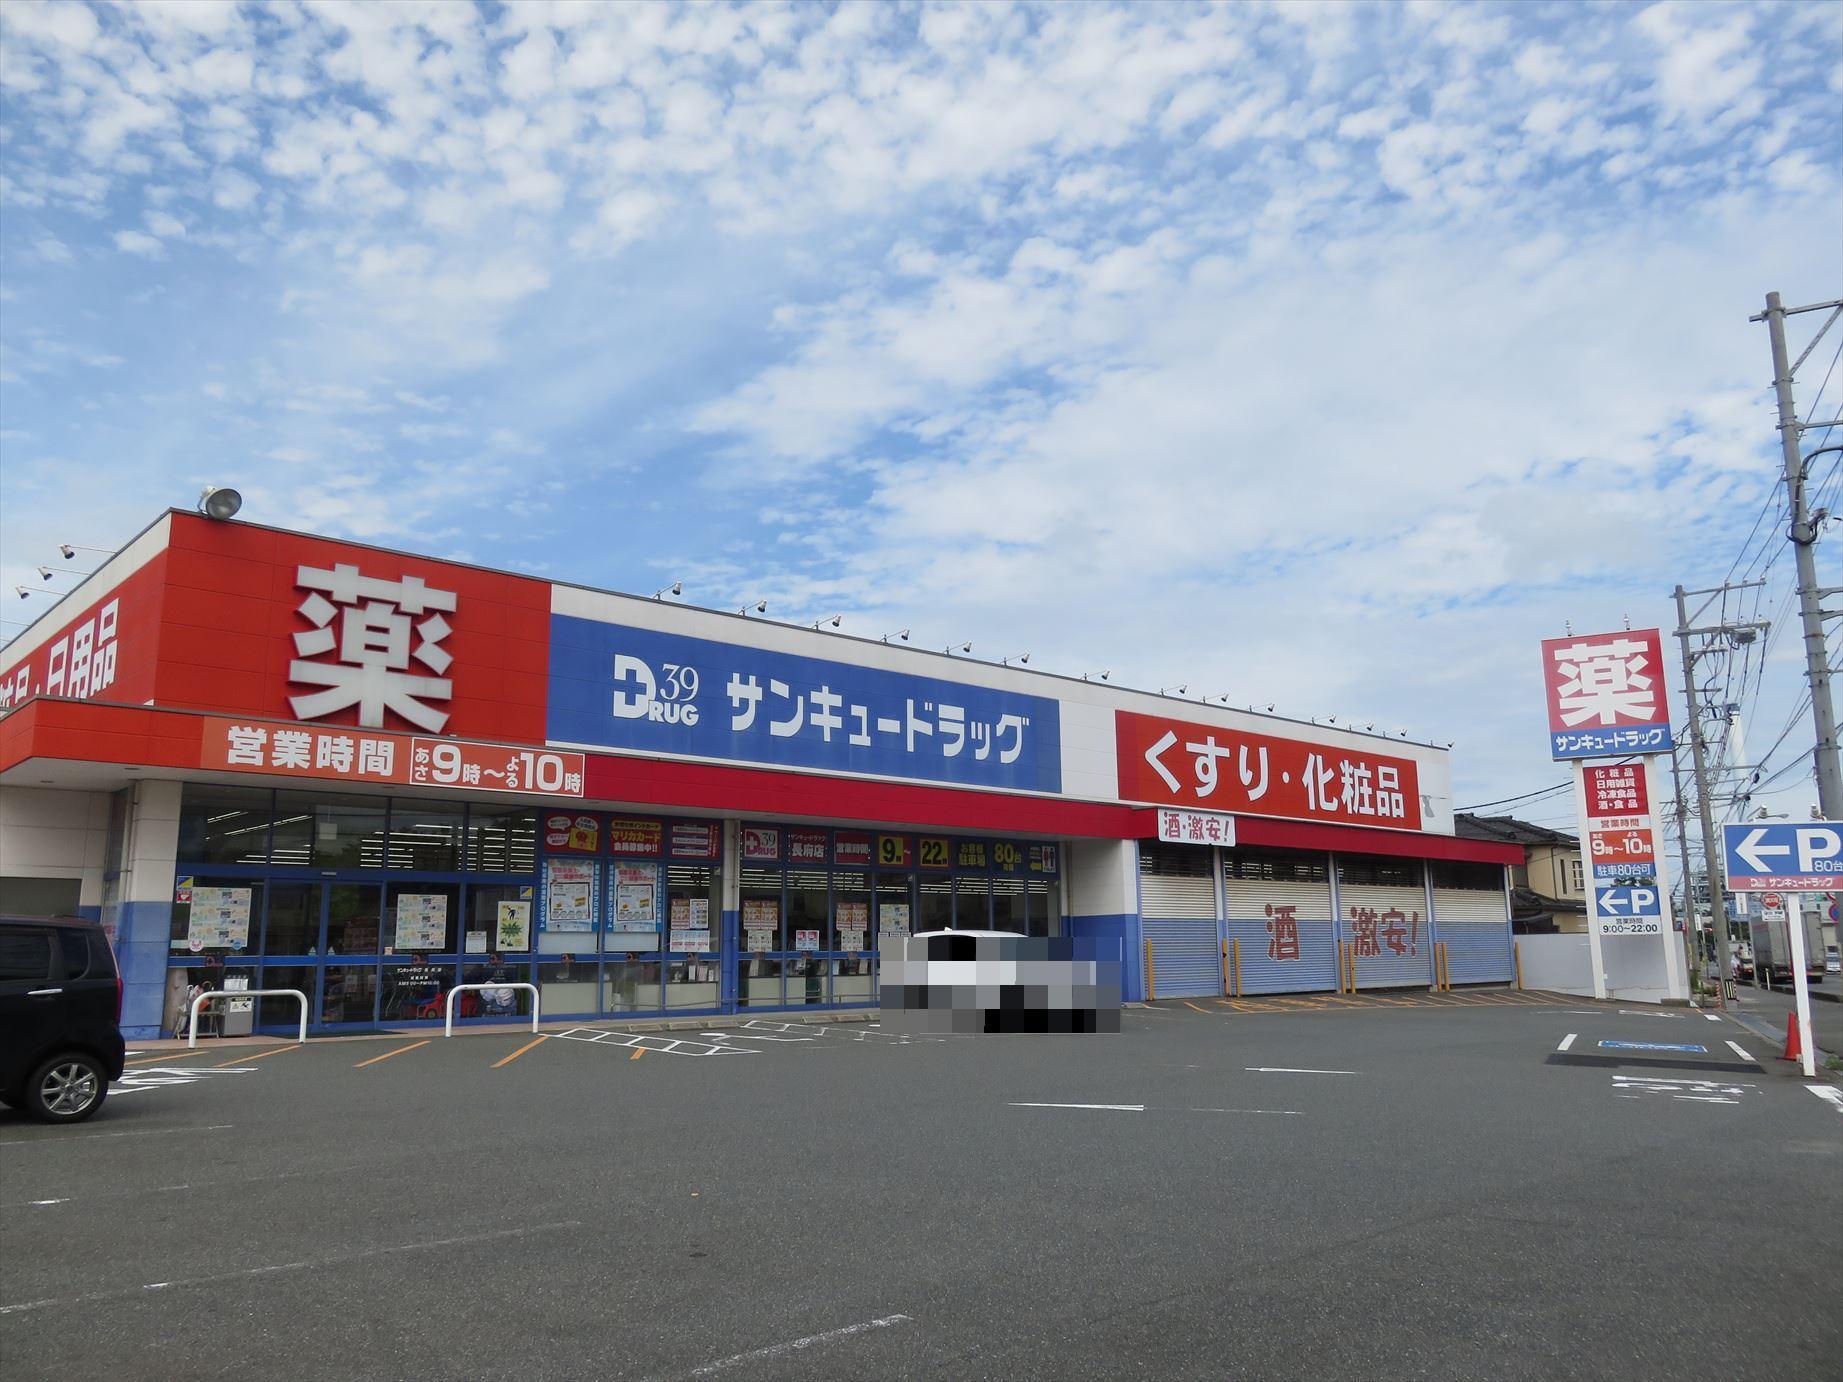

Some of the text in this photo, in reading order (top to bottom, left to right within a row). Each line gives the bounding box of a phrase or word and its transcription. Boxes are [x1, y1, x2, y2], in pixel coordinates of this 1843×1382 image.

[287, 563, 457, 733] 薬
[660, 664, 699, 702] 39
[1554, 639, 1657, 727] 薬
[726, 671, 1030, 764] サンキュードラッグ
[227, 726, 395, 777] 営業時間
[1556, 728, 1666, 751] サンキュードラッグ
[1144, 730, 1405, 819] くすり・化粧品
[1596, 778, 1635, 789] 日用雑貨
[1597, 789, 1637, 799] 冷凍食品
[1601, 818, 1640, 828] 営業時間
[1796, 828, 1841, 873] P
[1597, 864, 1651, 876] 駐車80台可
[1769, 877, 1835, 888] サンキュードラッグ
[1631, 889, 1655, 914] P
